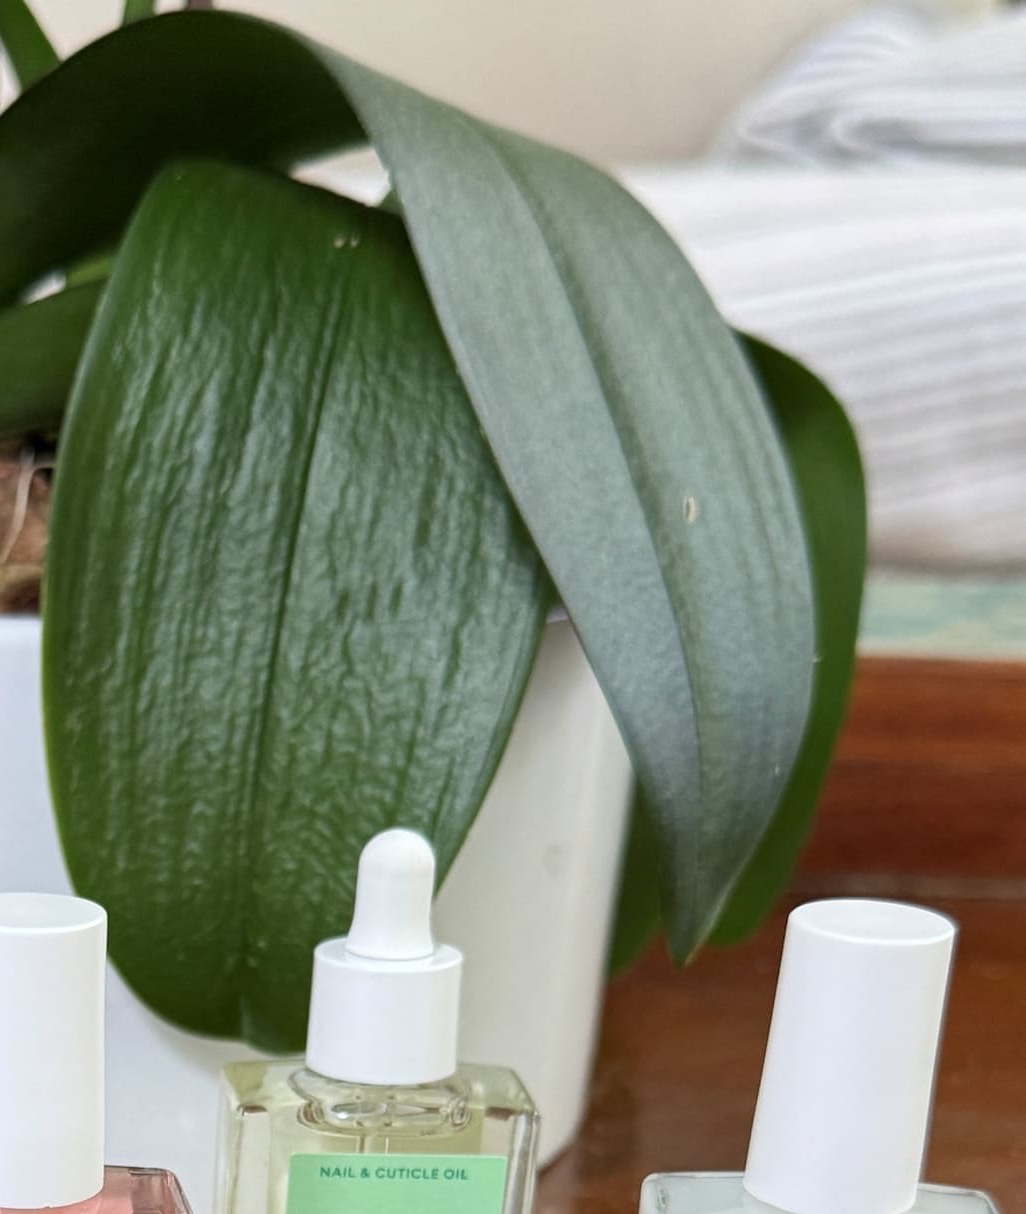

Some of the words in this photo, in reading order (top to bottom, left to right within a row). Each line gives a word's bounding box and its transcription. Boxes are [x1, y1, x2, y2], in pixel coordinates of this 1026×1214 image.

[319, 1167, 355, 1178] NAIL
[360, 1167, 370, 1178] &
[375, 1168, 439, 1180] CUTICLE
[443, 1168, 468, 1180] OIL
